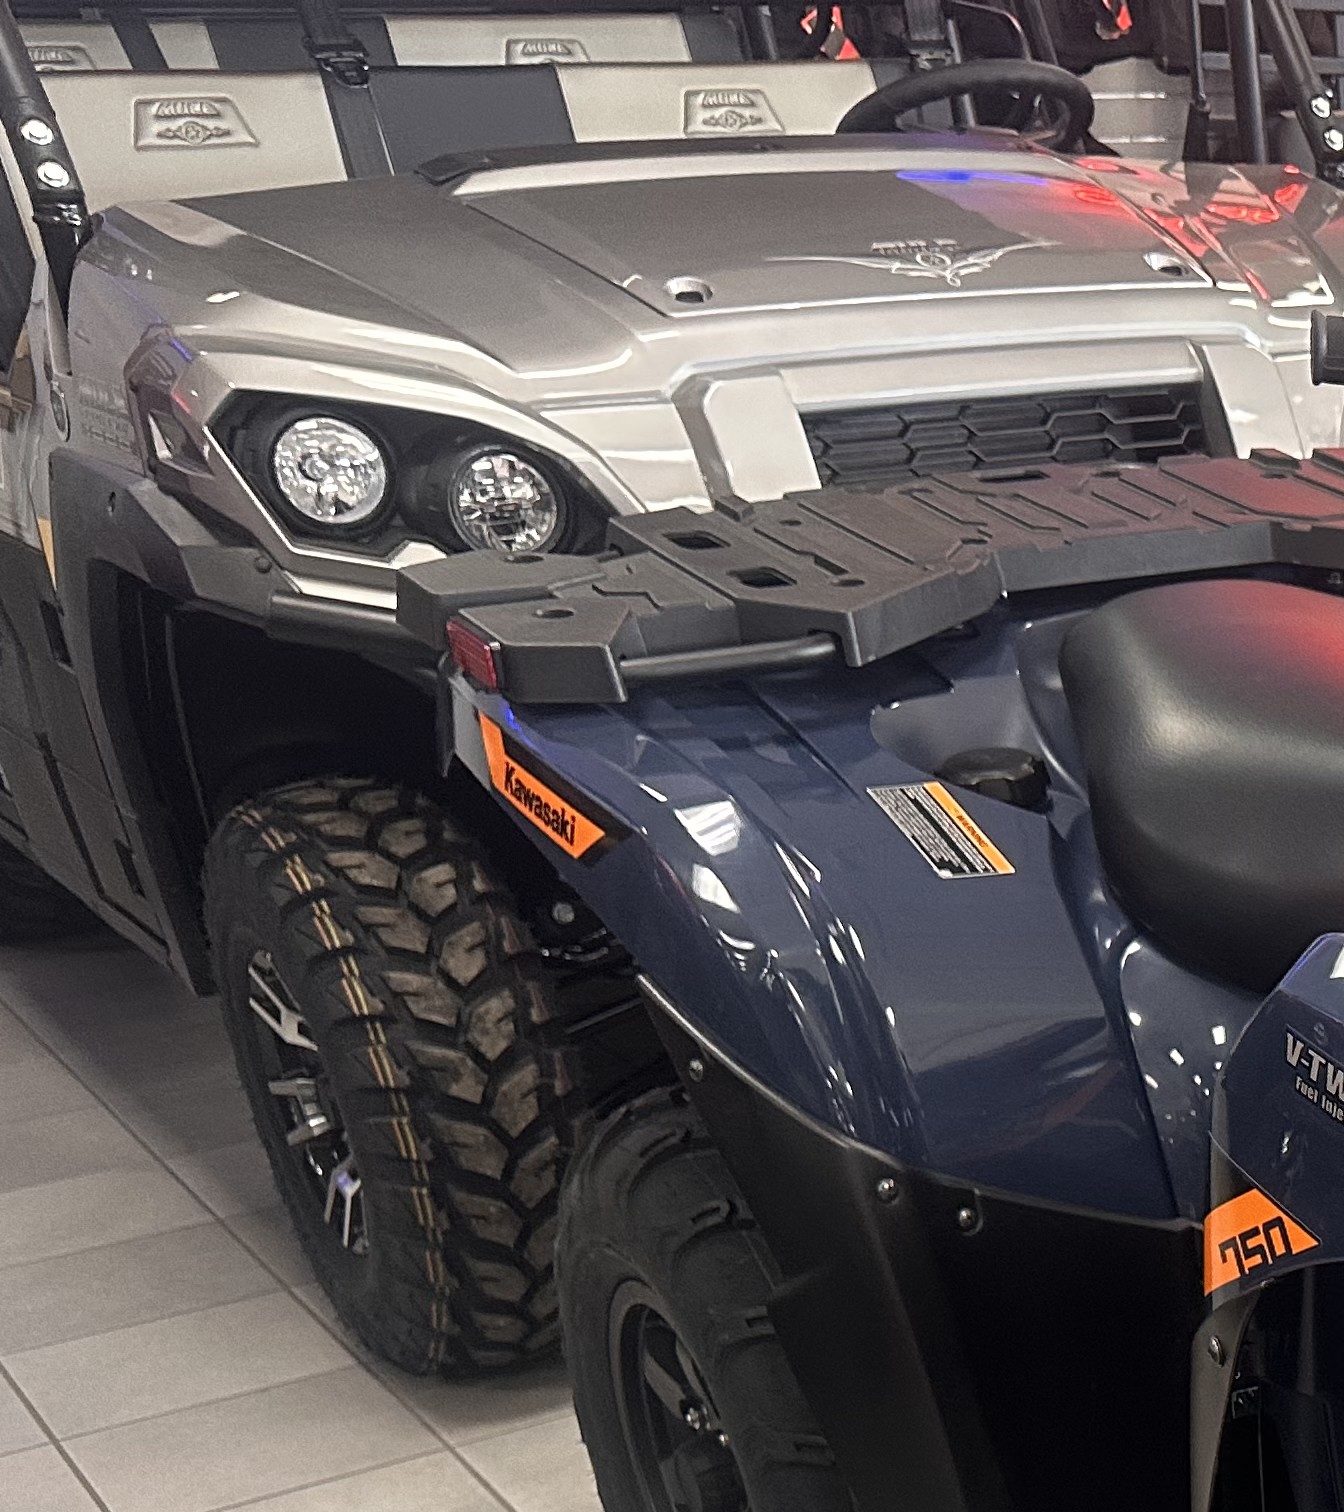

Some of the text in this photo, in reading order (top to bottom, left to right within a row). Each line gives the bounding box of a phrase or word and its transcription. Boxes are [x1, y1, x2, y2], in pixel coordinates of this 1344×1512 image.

[504, 761, 576, 847] Kawasaki
[1295, 1075, 1319, 1104] Fuel
[1217, 1215, 1294, 1277] 750
